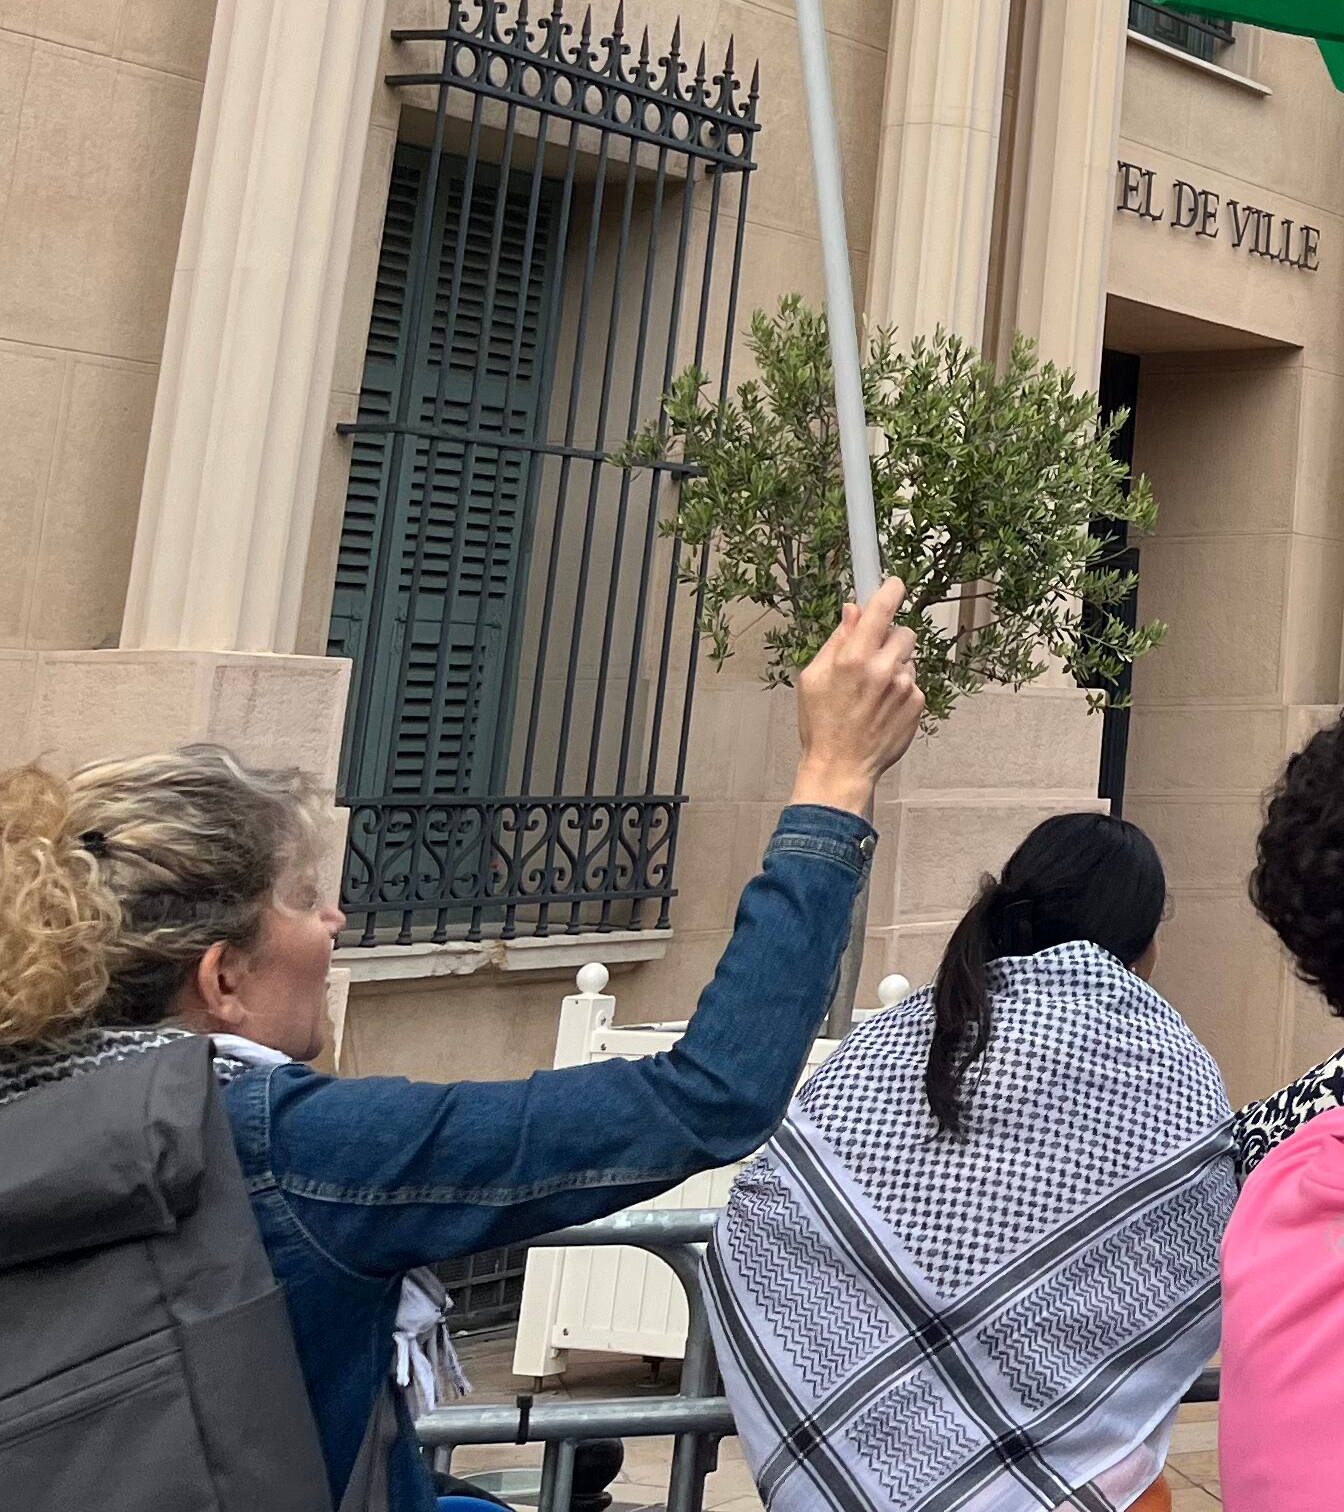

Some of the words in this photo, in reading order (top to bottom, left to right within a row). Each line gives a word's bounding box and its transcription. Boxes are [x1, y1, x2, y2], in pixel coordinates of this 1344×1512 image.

[1116, 160, 1165, 221] EL
[1170, 178, 1220, 238] DE
[1226, 198, 1321, 272] VILLE
